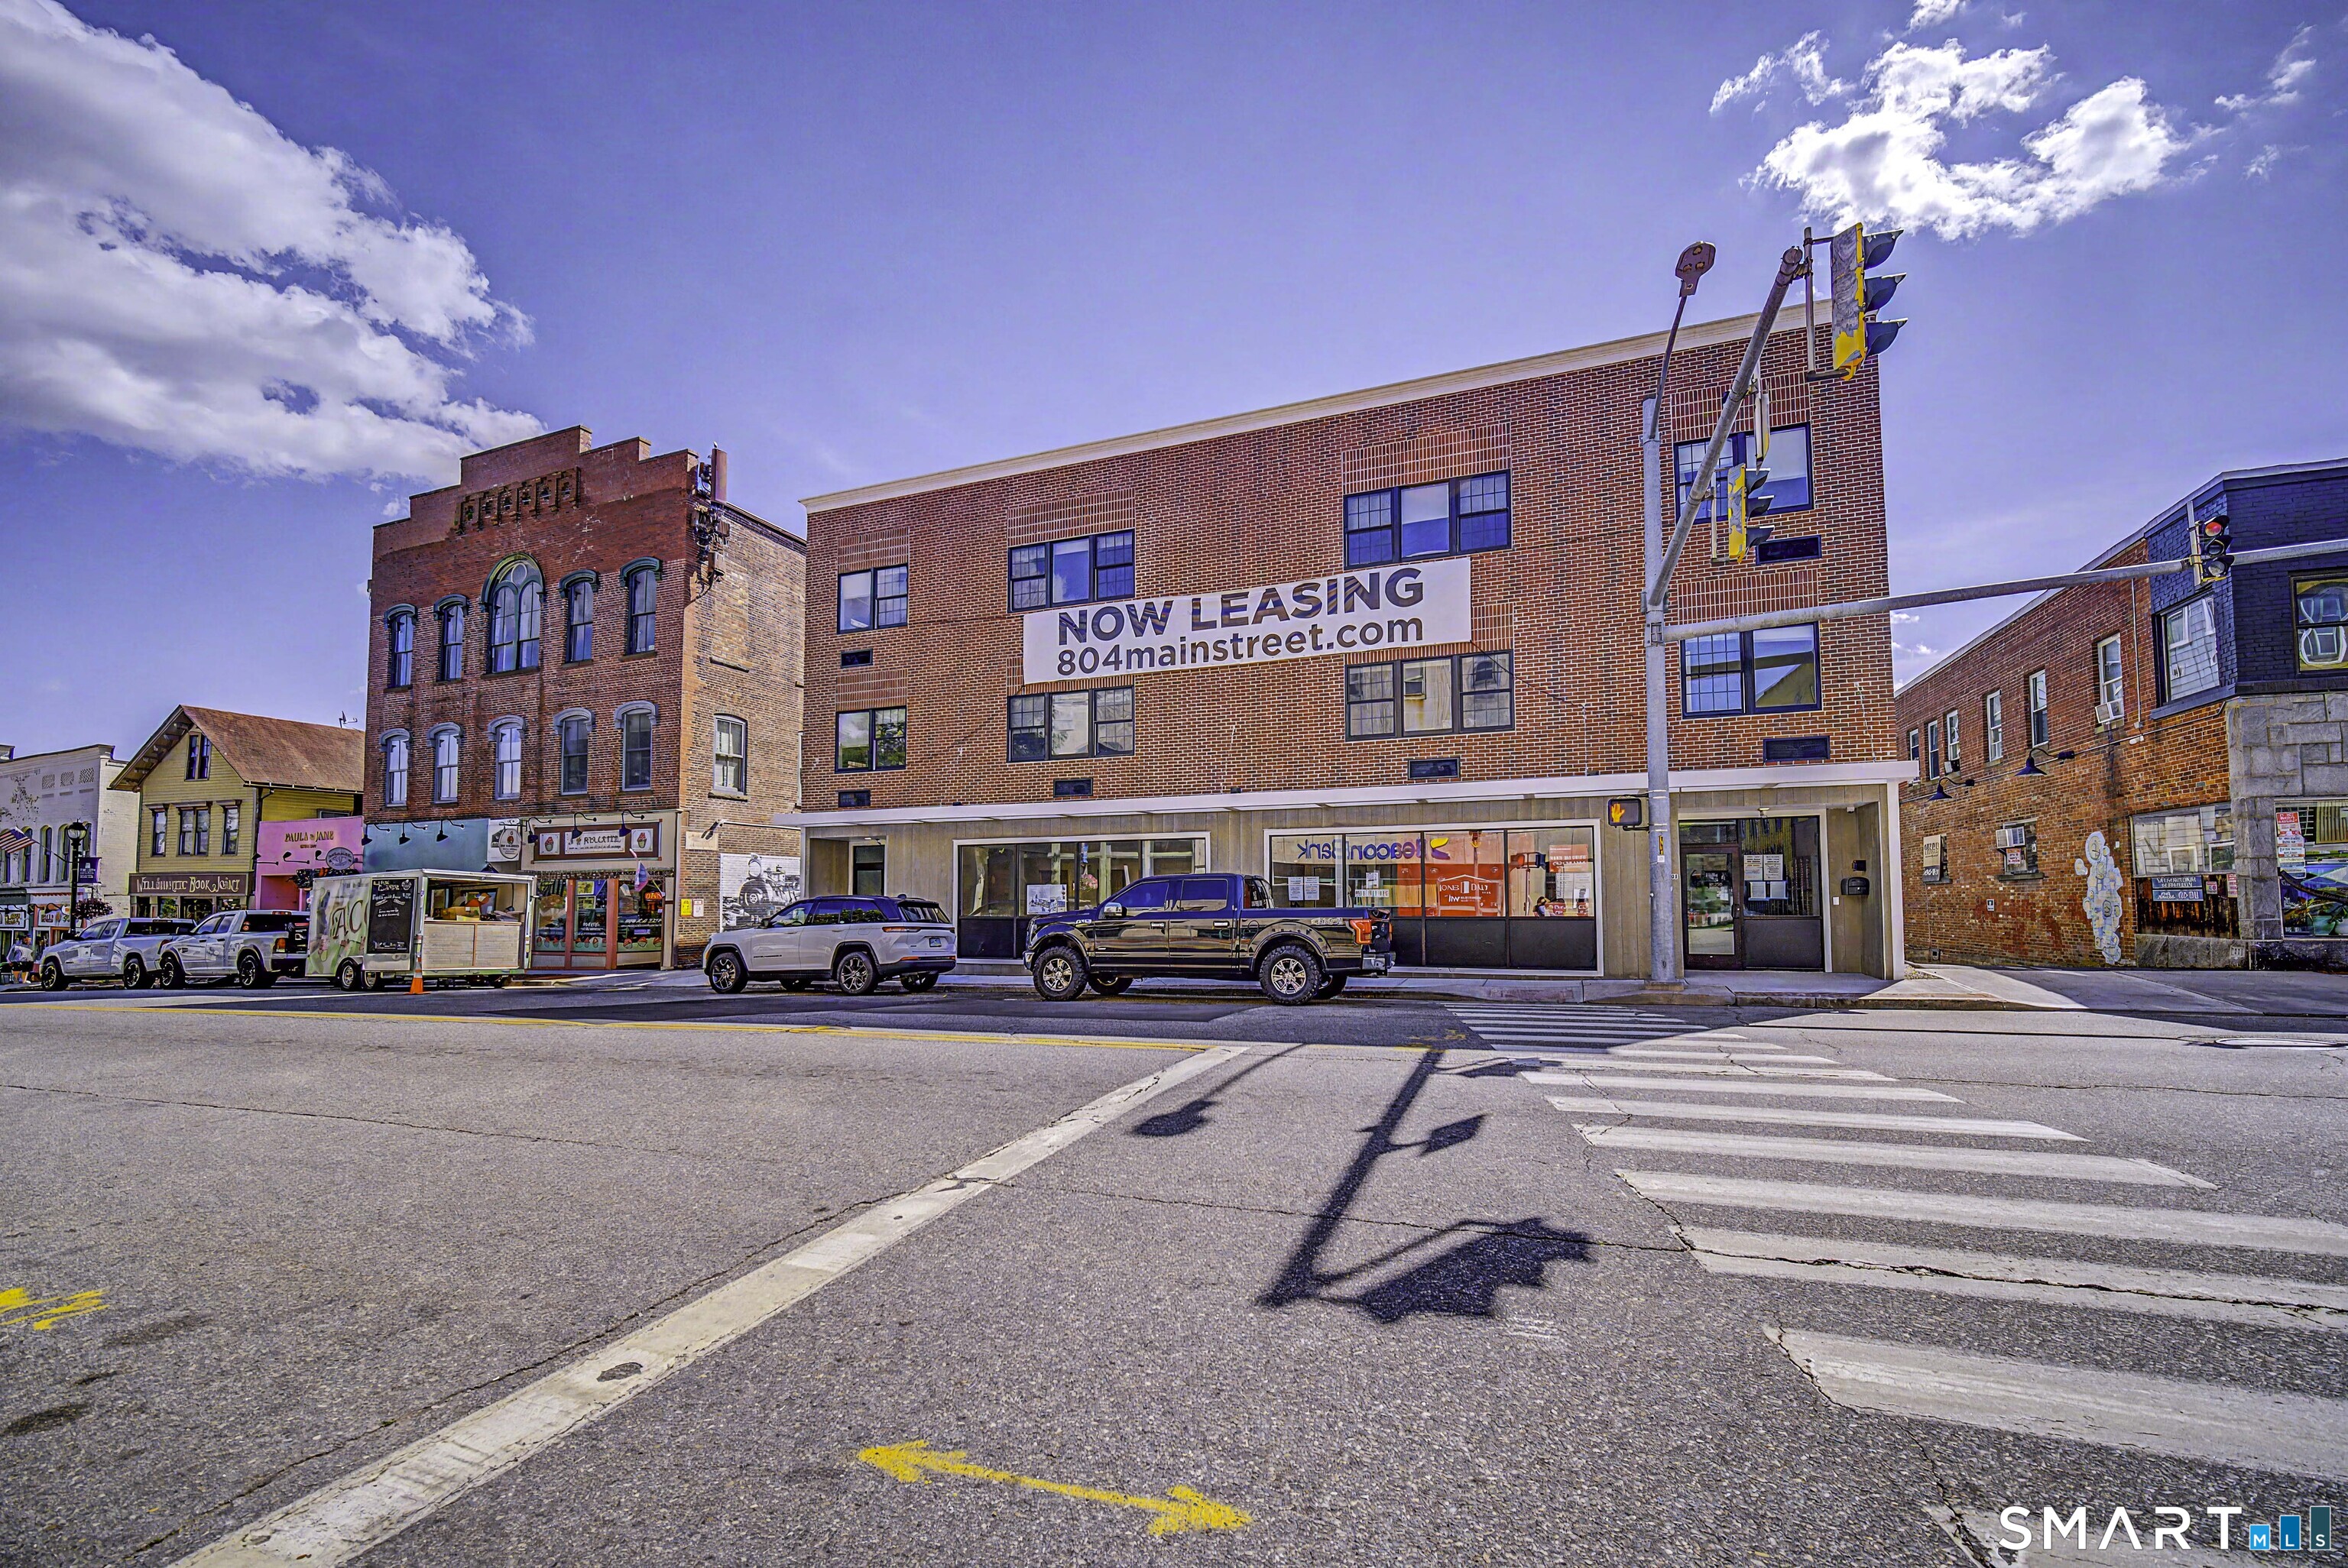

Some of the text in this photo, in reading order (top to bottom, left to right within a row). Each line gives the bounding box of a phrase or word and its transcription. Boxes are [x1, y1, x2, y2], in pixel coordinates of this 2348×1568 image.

[1059, 567, 1424, 646] NOW LEASING
[1057, 617, 1424, 676] 804mainstreet.com
